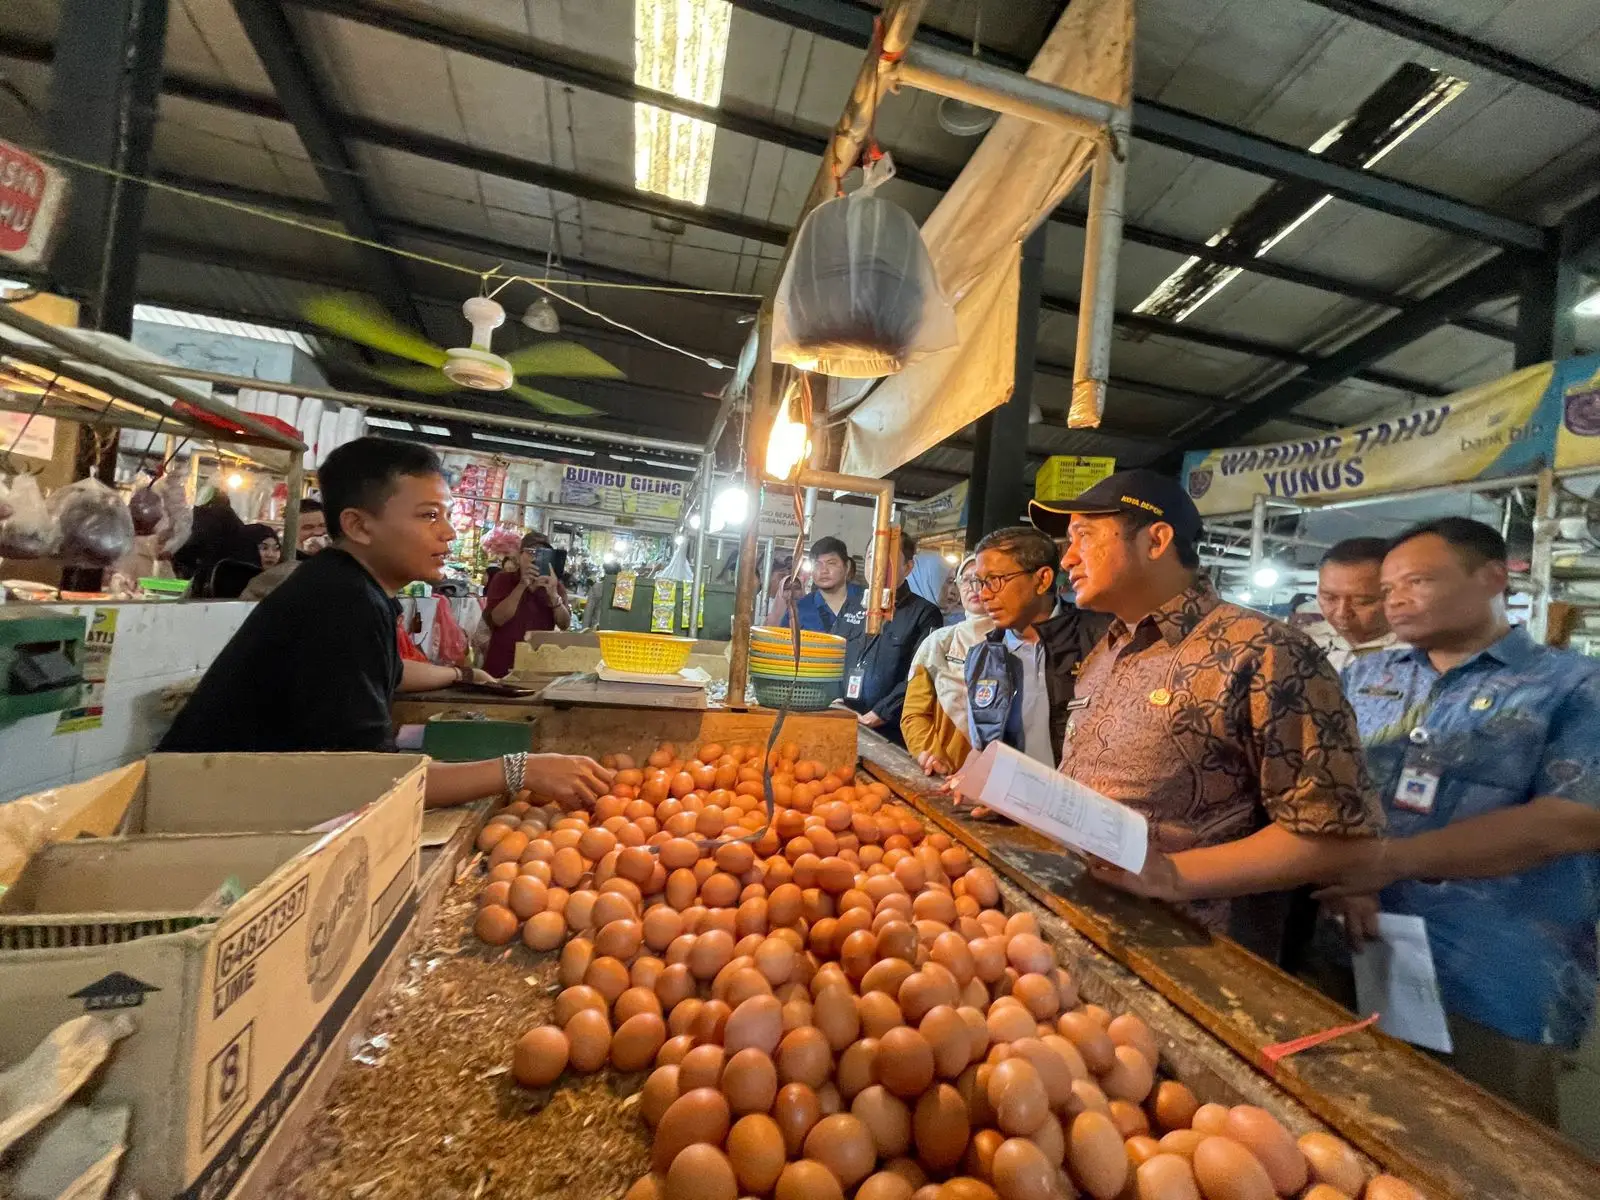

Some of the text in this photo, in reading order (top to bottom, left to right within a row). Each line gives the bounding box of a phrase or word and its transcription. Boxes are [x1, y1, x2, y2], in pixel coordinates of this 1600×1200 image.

[1220, 405, 1451, 477] WARUNG TAHU
[1461, 428, 1502, 451] bank
[566, 466, 683, 497] BUMBU GILING
[1263, 456, 1365, 498] YUNUS
[1121, 495, 1164, 516] KOTA DEPOK
[220, 883, 306, 978] 64827397
[212, 962, 257, 1021] LIME
